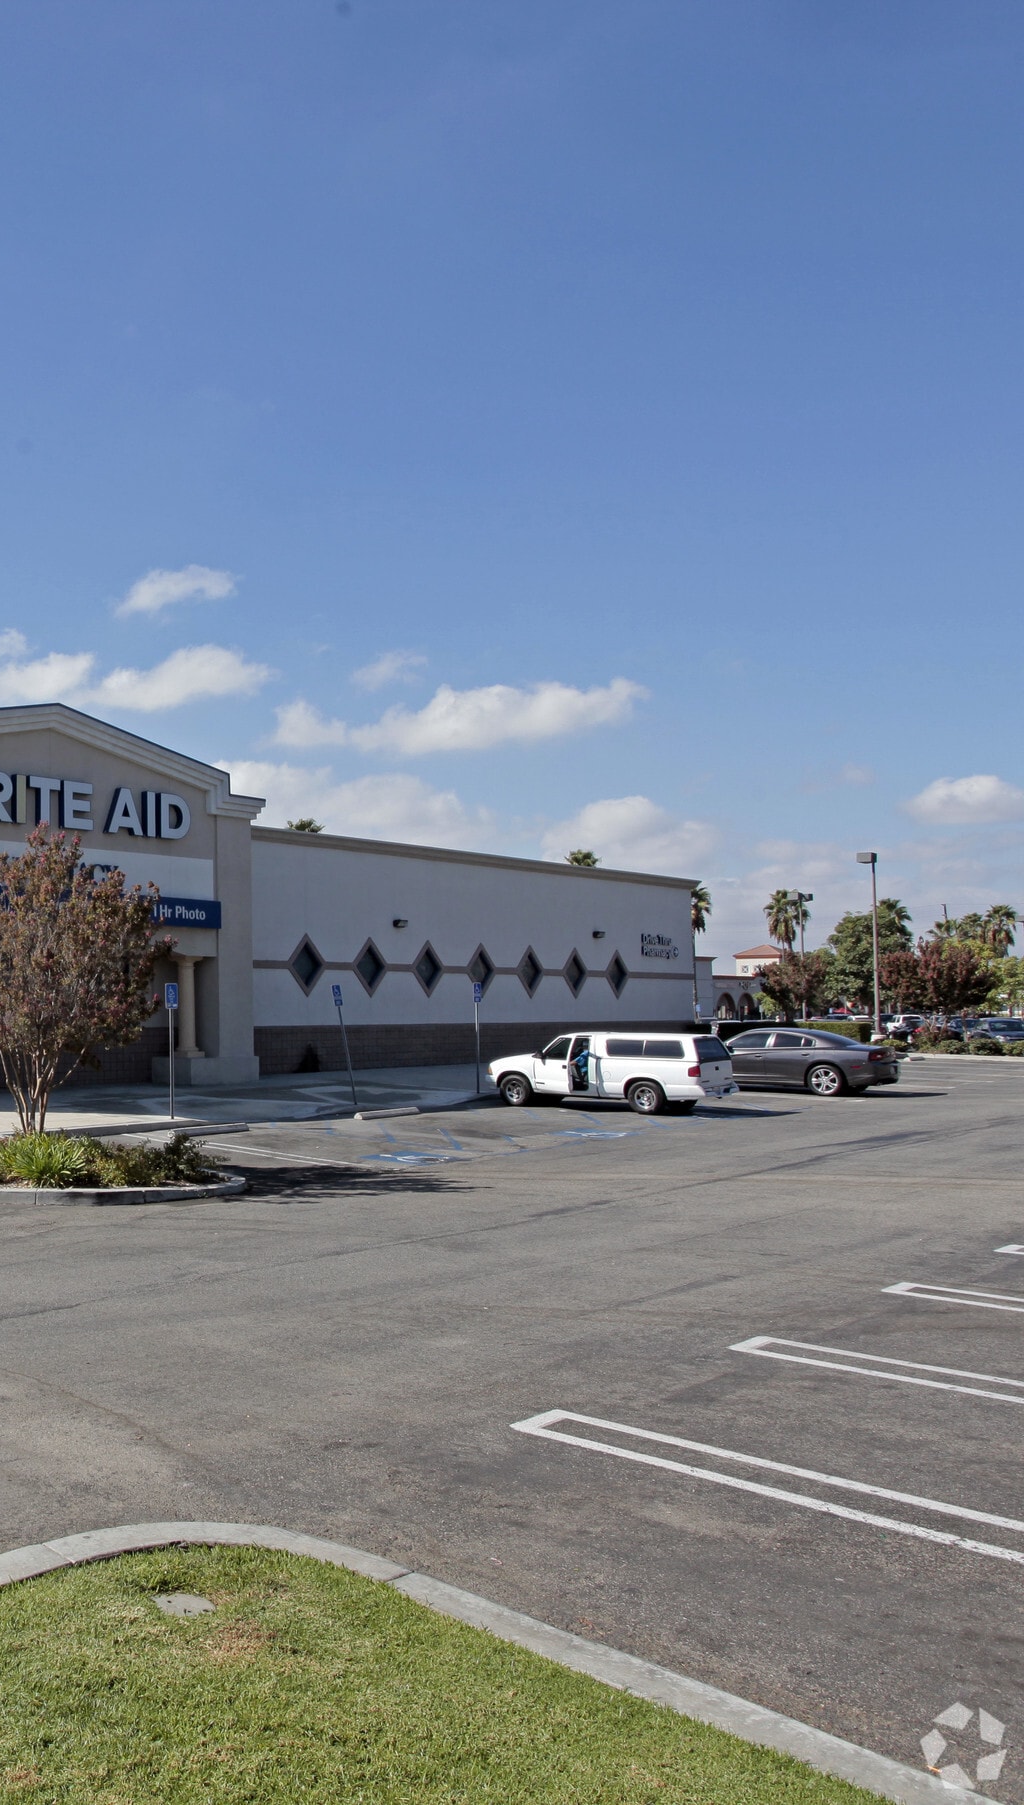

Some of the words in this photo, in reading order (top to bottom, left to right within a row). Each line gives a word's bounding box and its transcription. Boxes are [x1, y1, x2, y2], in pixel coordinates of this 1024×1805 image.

[103, 787, 191, 840] AID
[159, 904, 173, 918] Hr
[175, 905, 206, 920] Photo
